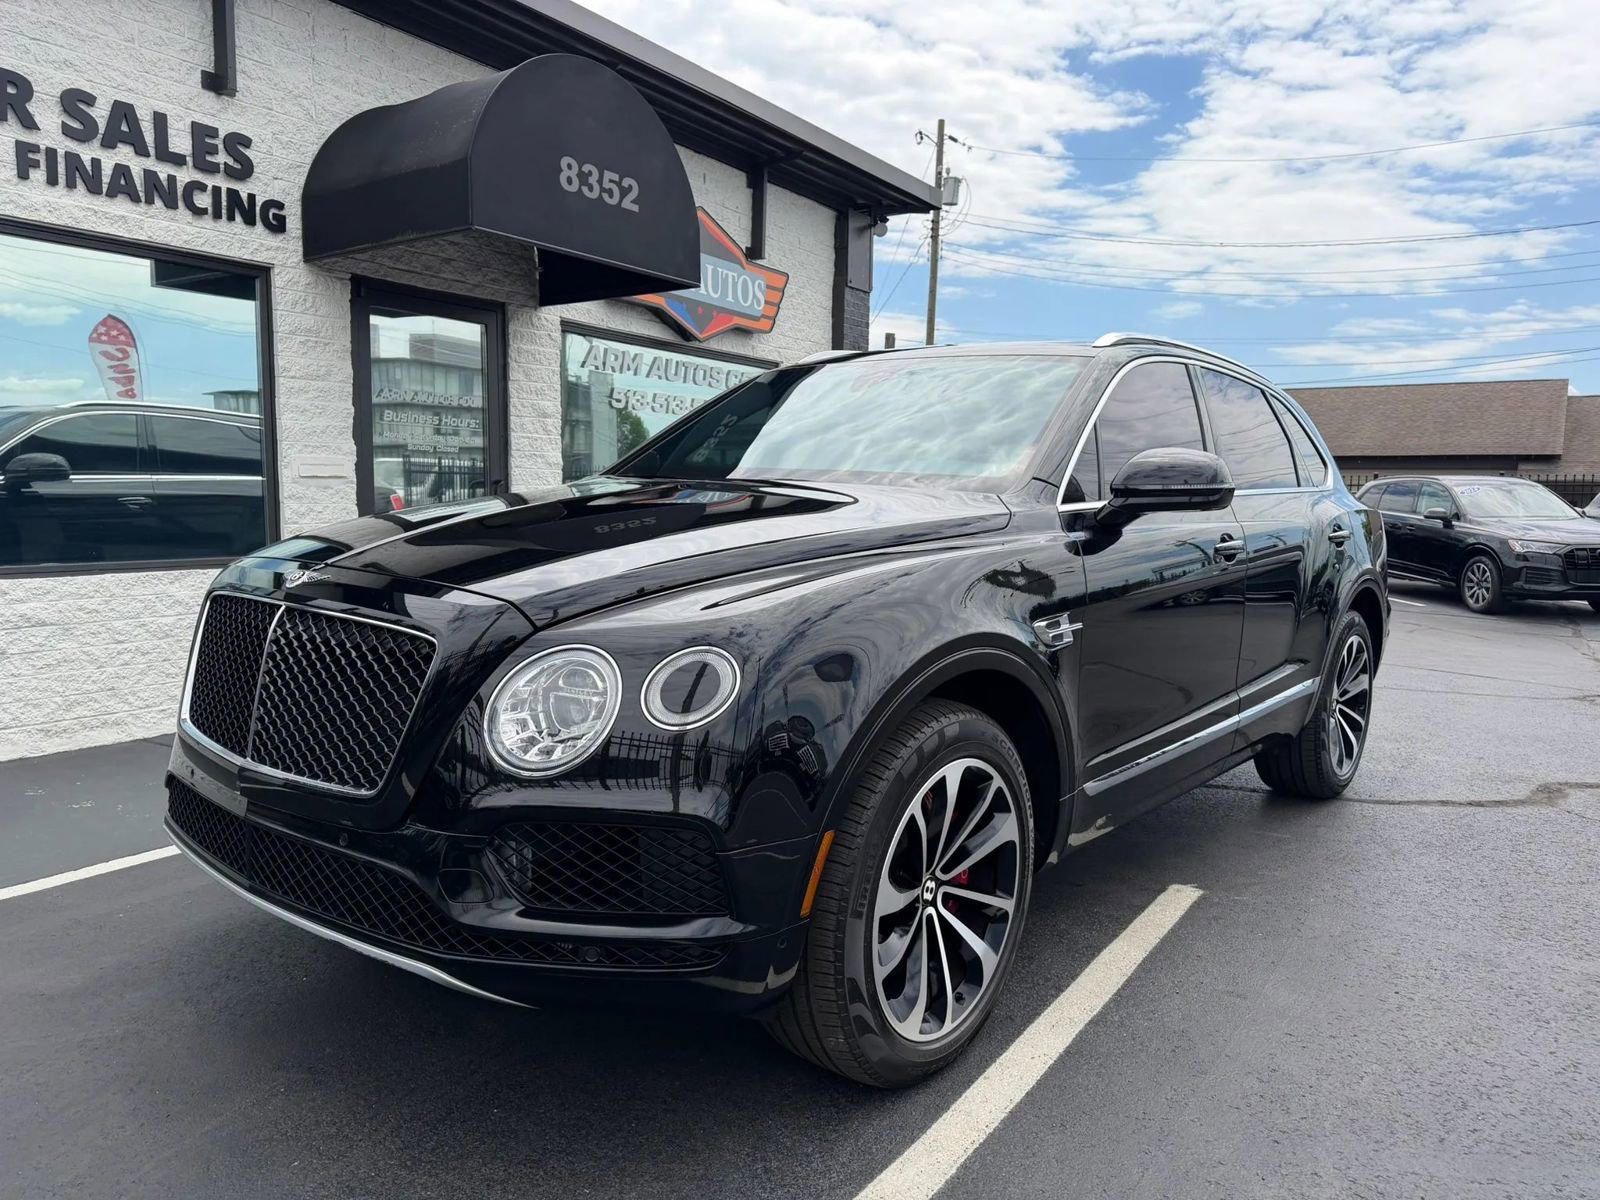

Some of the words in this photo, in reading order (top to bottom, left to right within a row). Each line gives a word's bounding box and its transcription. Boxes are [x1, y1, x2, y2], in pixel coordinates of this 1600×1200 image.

[60, 88, 254, 181] SALES
[15, 139, 287, 233] FINANCING
[560, 156, 640, 213] 8352
[582, 344, 644, 376] ARM
[647, 356, 723, 390] AUTOS
[383, 410, 439, 425] Business
[441, 415, 480, 428] Hours:
[407, 443, 434, 453] Sunday
[436, 444, 460, 453] Closed
